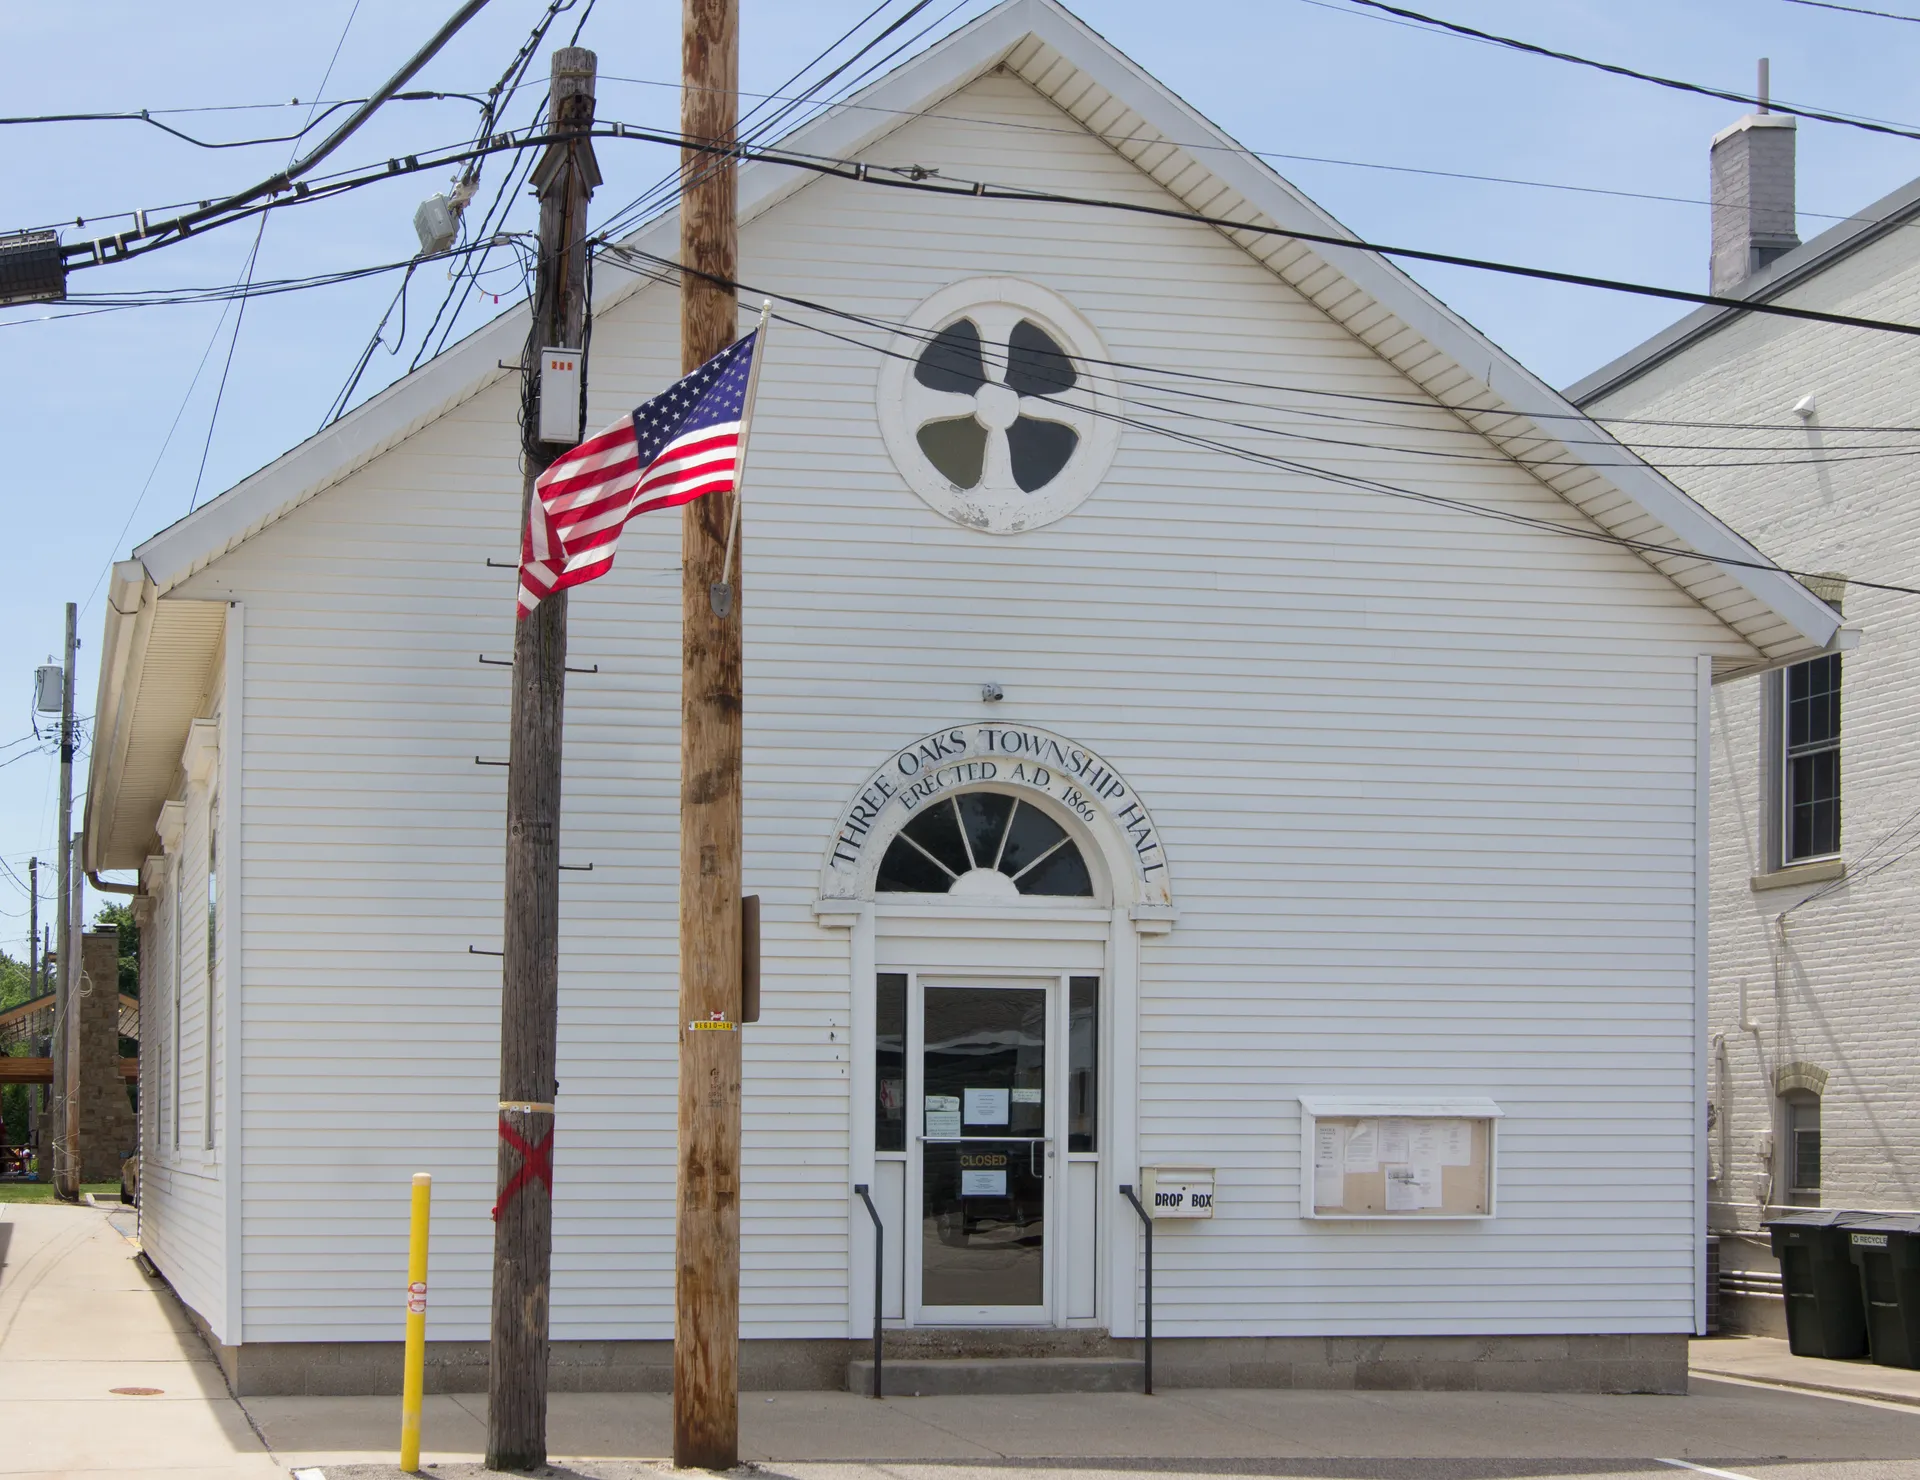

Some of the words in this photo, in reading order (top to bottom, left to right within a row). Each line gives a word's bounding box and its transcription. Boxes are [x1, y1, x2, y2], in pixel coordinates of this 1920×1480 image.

[898, 761, 997, 810] ERECTED
[1010, 762, 1051, 791] A.D.
[1061, 786, 1097, 823] 1866
[829, 774, 898, 870] THREE
[897, 730, 967, 776] OAKS
[978, 729, 1125, 800] TOWNSHIP
[1118, 802, 1165, 884] HALL
[960, 1154, 1008, 1167] CLOSED
[1154, 1193, 1184, 1207] DROP
[1191, 1194, 1213, 1208] BOX
[1860, 1235, 1887, 1244] RECYCLE
